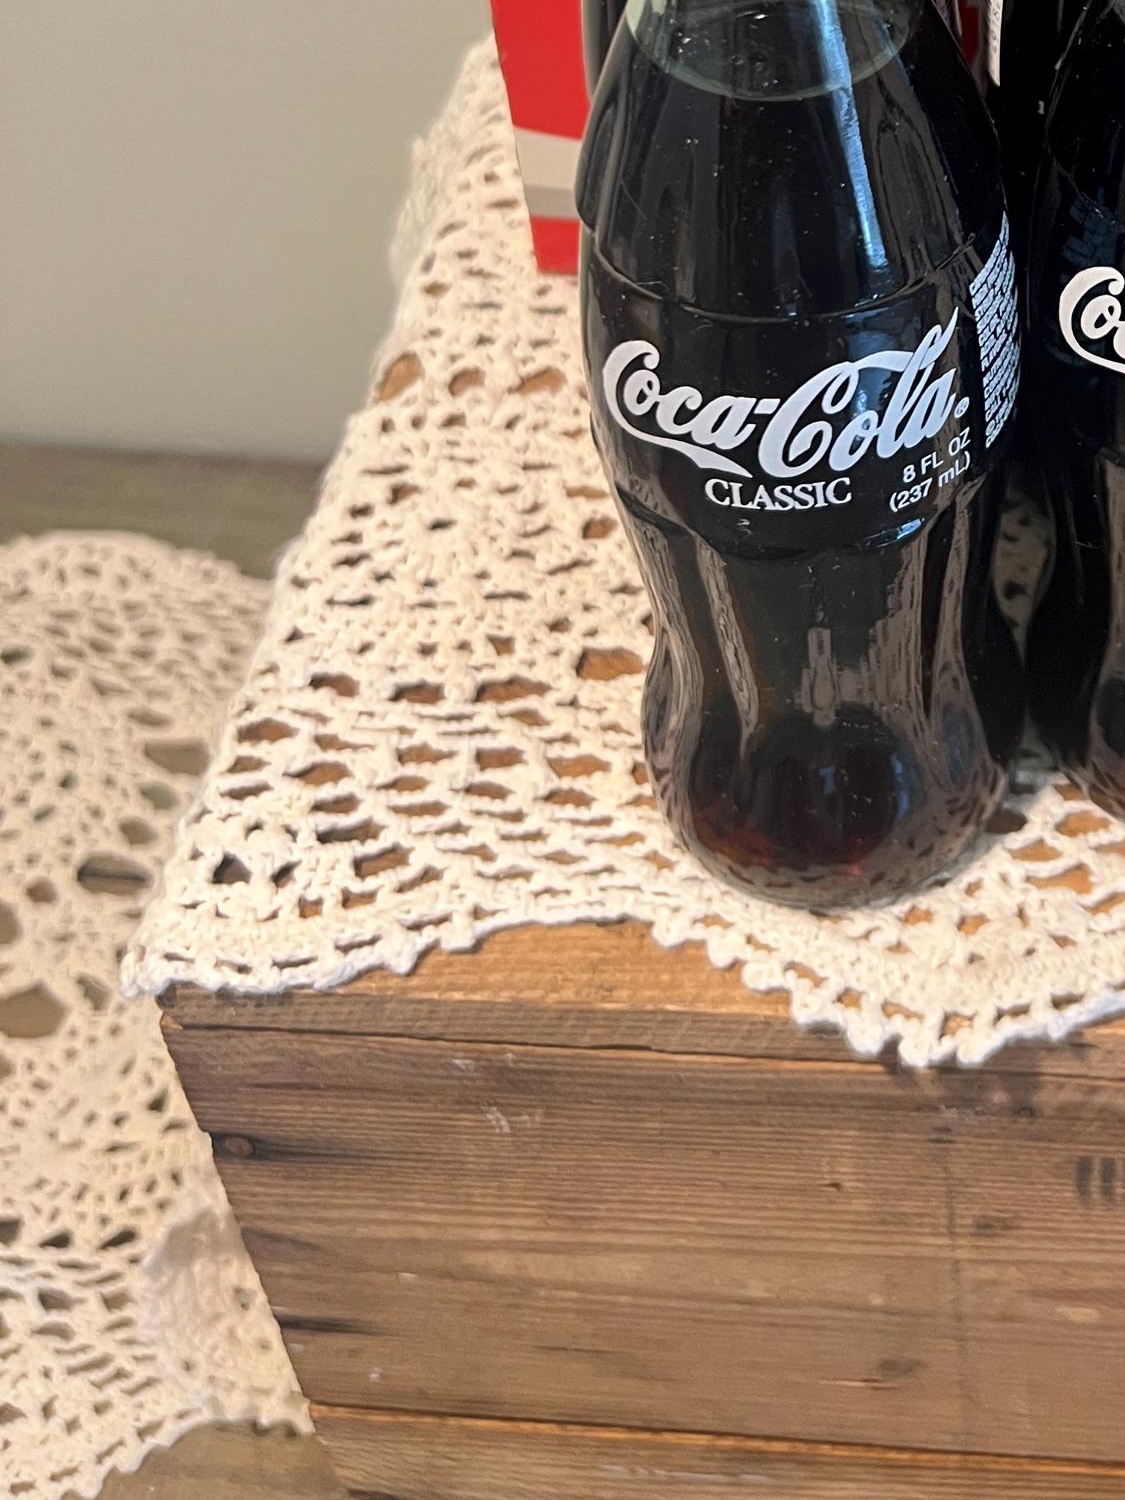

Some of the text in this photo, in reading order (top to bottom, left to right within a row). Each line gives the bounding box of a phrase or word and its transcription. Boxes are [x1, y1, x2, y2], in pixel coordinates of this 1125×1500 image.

[602, 306, 960, 480] Coca-Cola
[890, 450, 971, 513] (237 mL)
[903, 426, 971, 483] 8 FL OZ
[704, 477, 853, 511] CLASSIC
